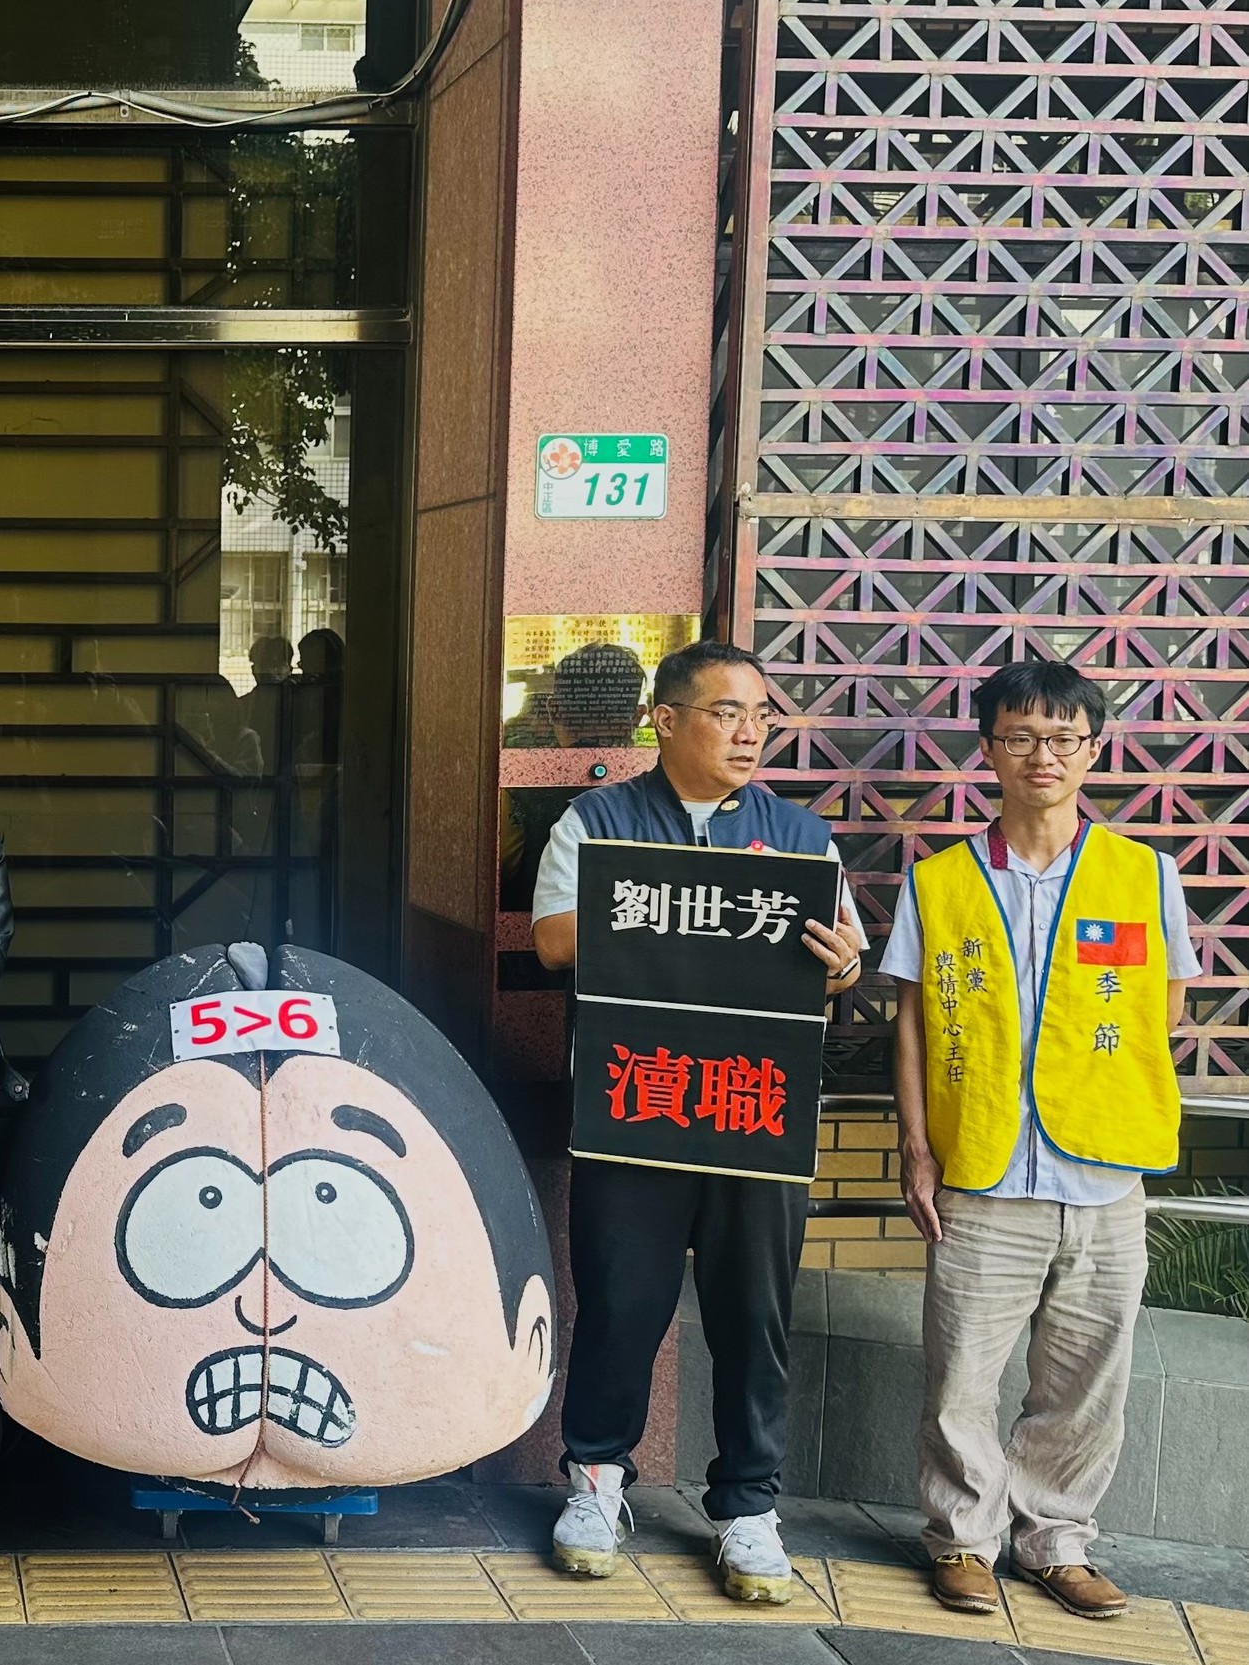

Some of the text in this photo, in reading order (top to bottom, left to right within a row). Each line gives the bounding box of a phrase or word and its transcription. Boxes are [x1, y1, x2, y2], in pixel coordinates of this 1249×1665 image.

[583, 438, 664, 458] 博愛路
[542, 482, 554, 514] 中正區
[584, 472, 650, 506] 131
[610, 879, 801, 944] 劉世芳
[960, 937, 988, 993] 新黨
[190, 998, 319, 1046] 5>6
[1092, 970, 1123, 1057] 季節
[605, 1044, 788, 1137] 瀆職
